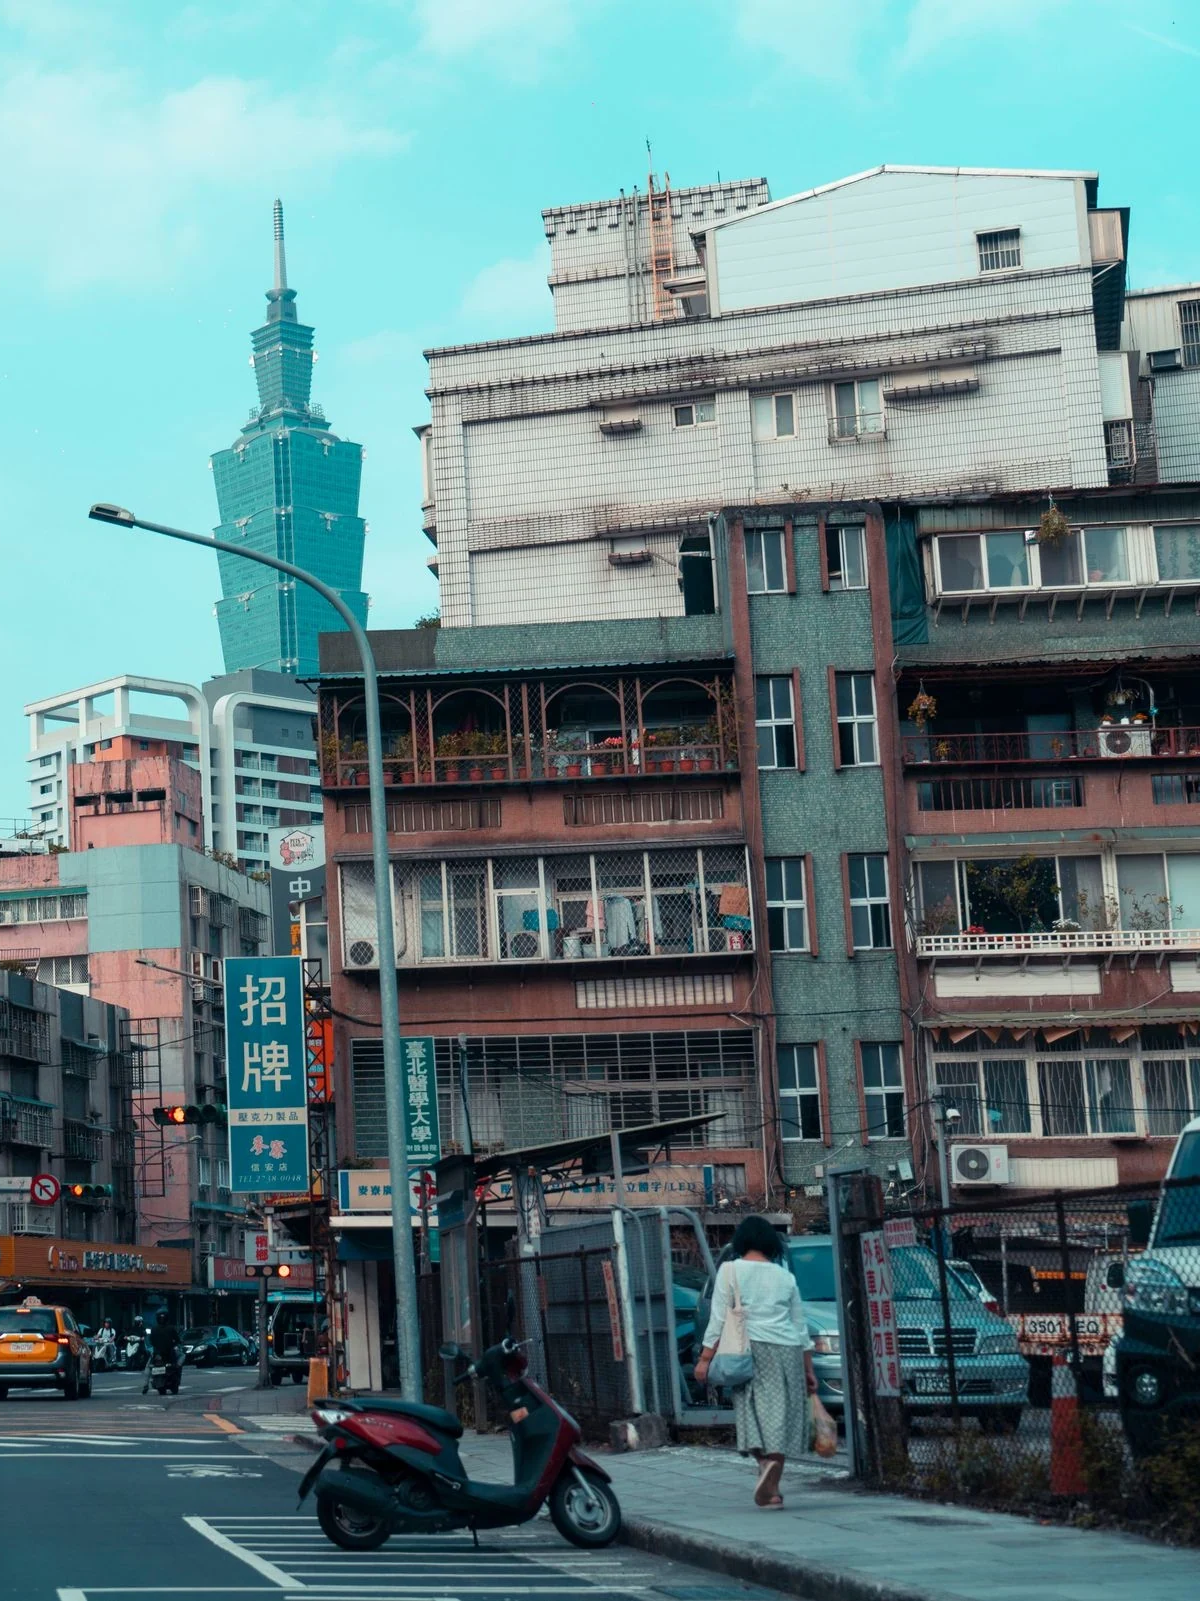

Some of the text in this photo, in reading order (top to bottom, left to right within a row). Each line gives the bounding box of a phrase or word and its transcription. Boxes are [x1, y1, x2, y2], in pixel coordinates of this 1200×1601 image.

[239, 974, 292, 1093] 招牌
[405, 1041, 432, 1143] 臺北醫學大學
[238, 1112, 299, 1123] 壓克力製品
[251, 1162, 288, 1172] 信安店
[1029, 1320, 1099, 1334] 3501EQ
